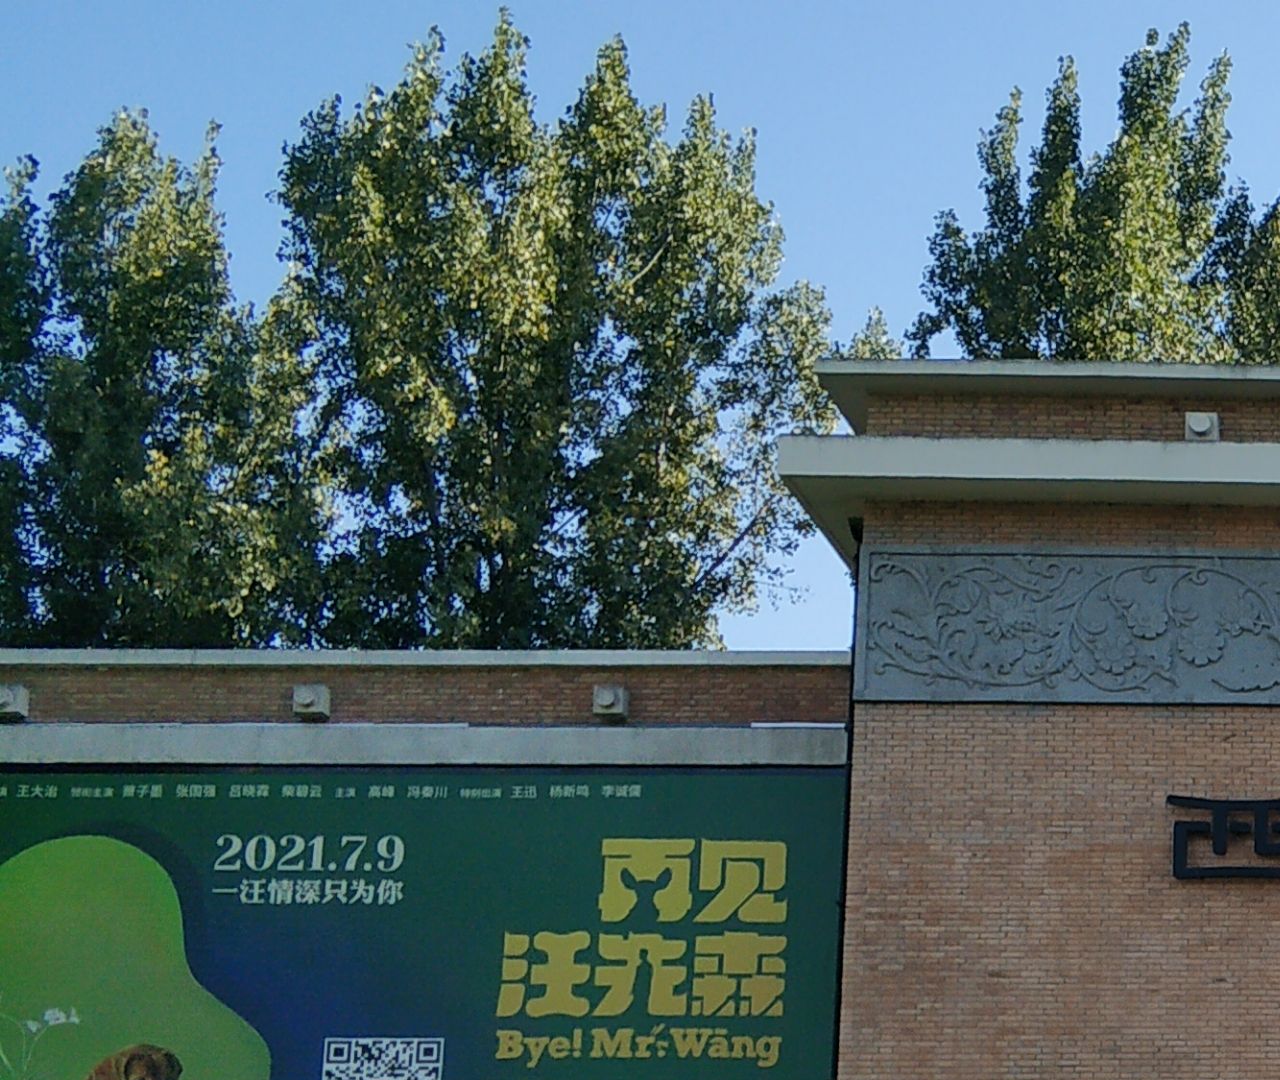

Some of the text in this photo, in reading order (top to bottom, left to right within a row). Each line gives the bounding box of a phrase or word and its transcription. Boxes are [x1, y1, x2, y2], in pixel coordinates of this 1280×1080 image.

[213, 834, 405, 873] 2021.7.9
[211, 878, 404, 905] 一汪情深只为你
[496, 931, 788, 1017] 汪先森
[495, 1028, 582, 1068] Bye!
